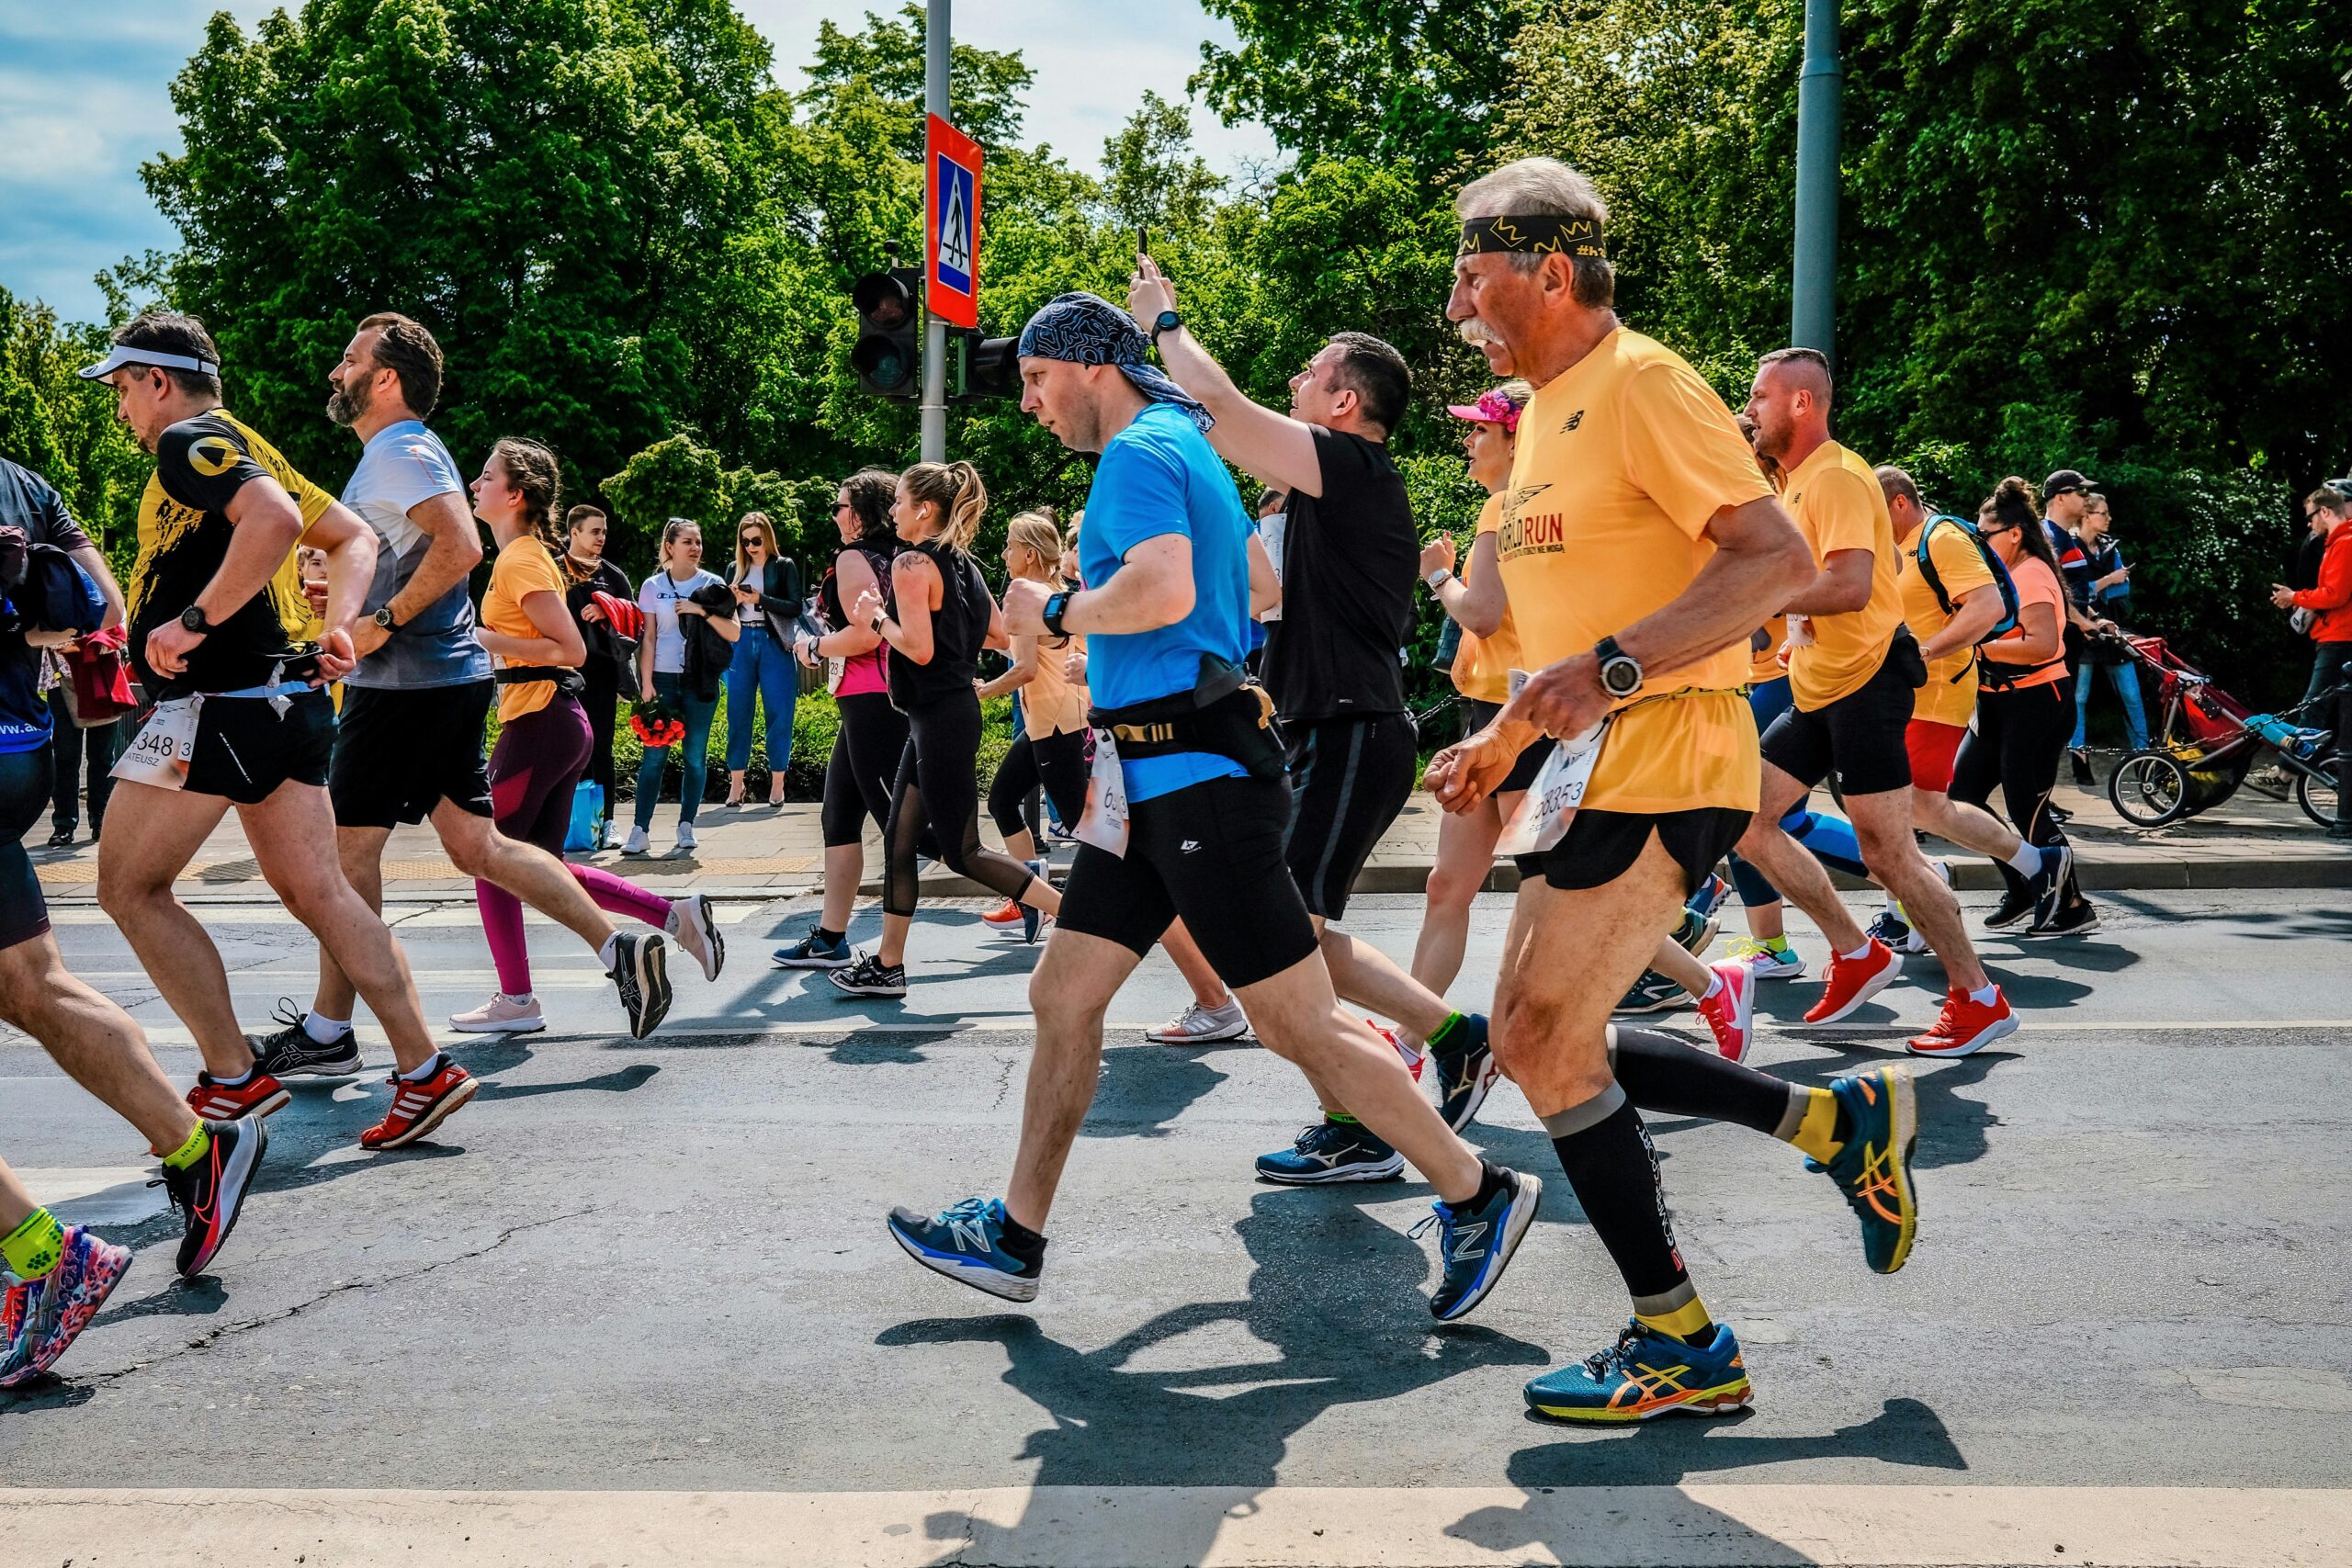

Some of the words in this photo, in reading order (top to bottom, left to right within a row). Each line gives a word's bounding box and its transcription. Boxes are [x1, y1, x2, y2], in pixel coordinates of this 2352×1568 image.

[1525, 513, 1563, 546] RUN
[131, 731, 173, 757] 348
[181, 742, 191, 756] 3
[1570, 781, 1583, 800] 3
